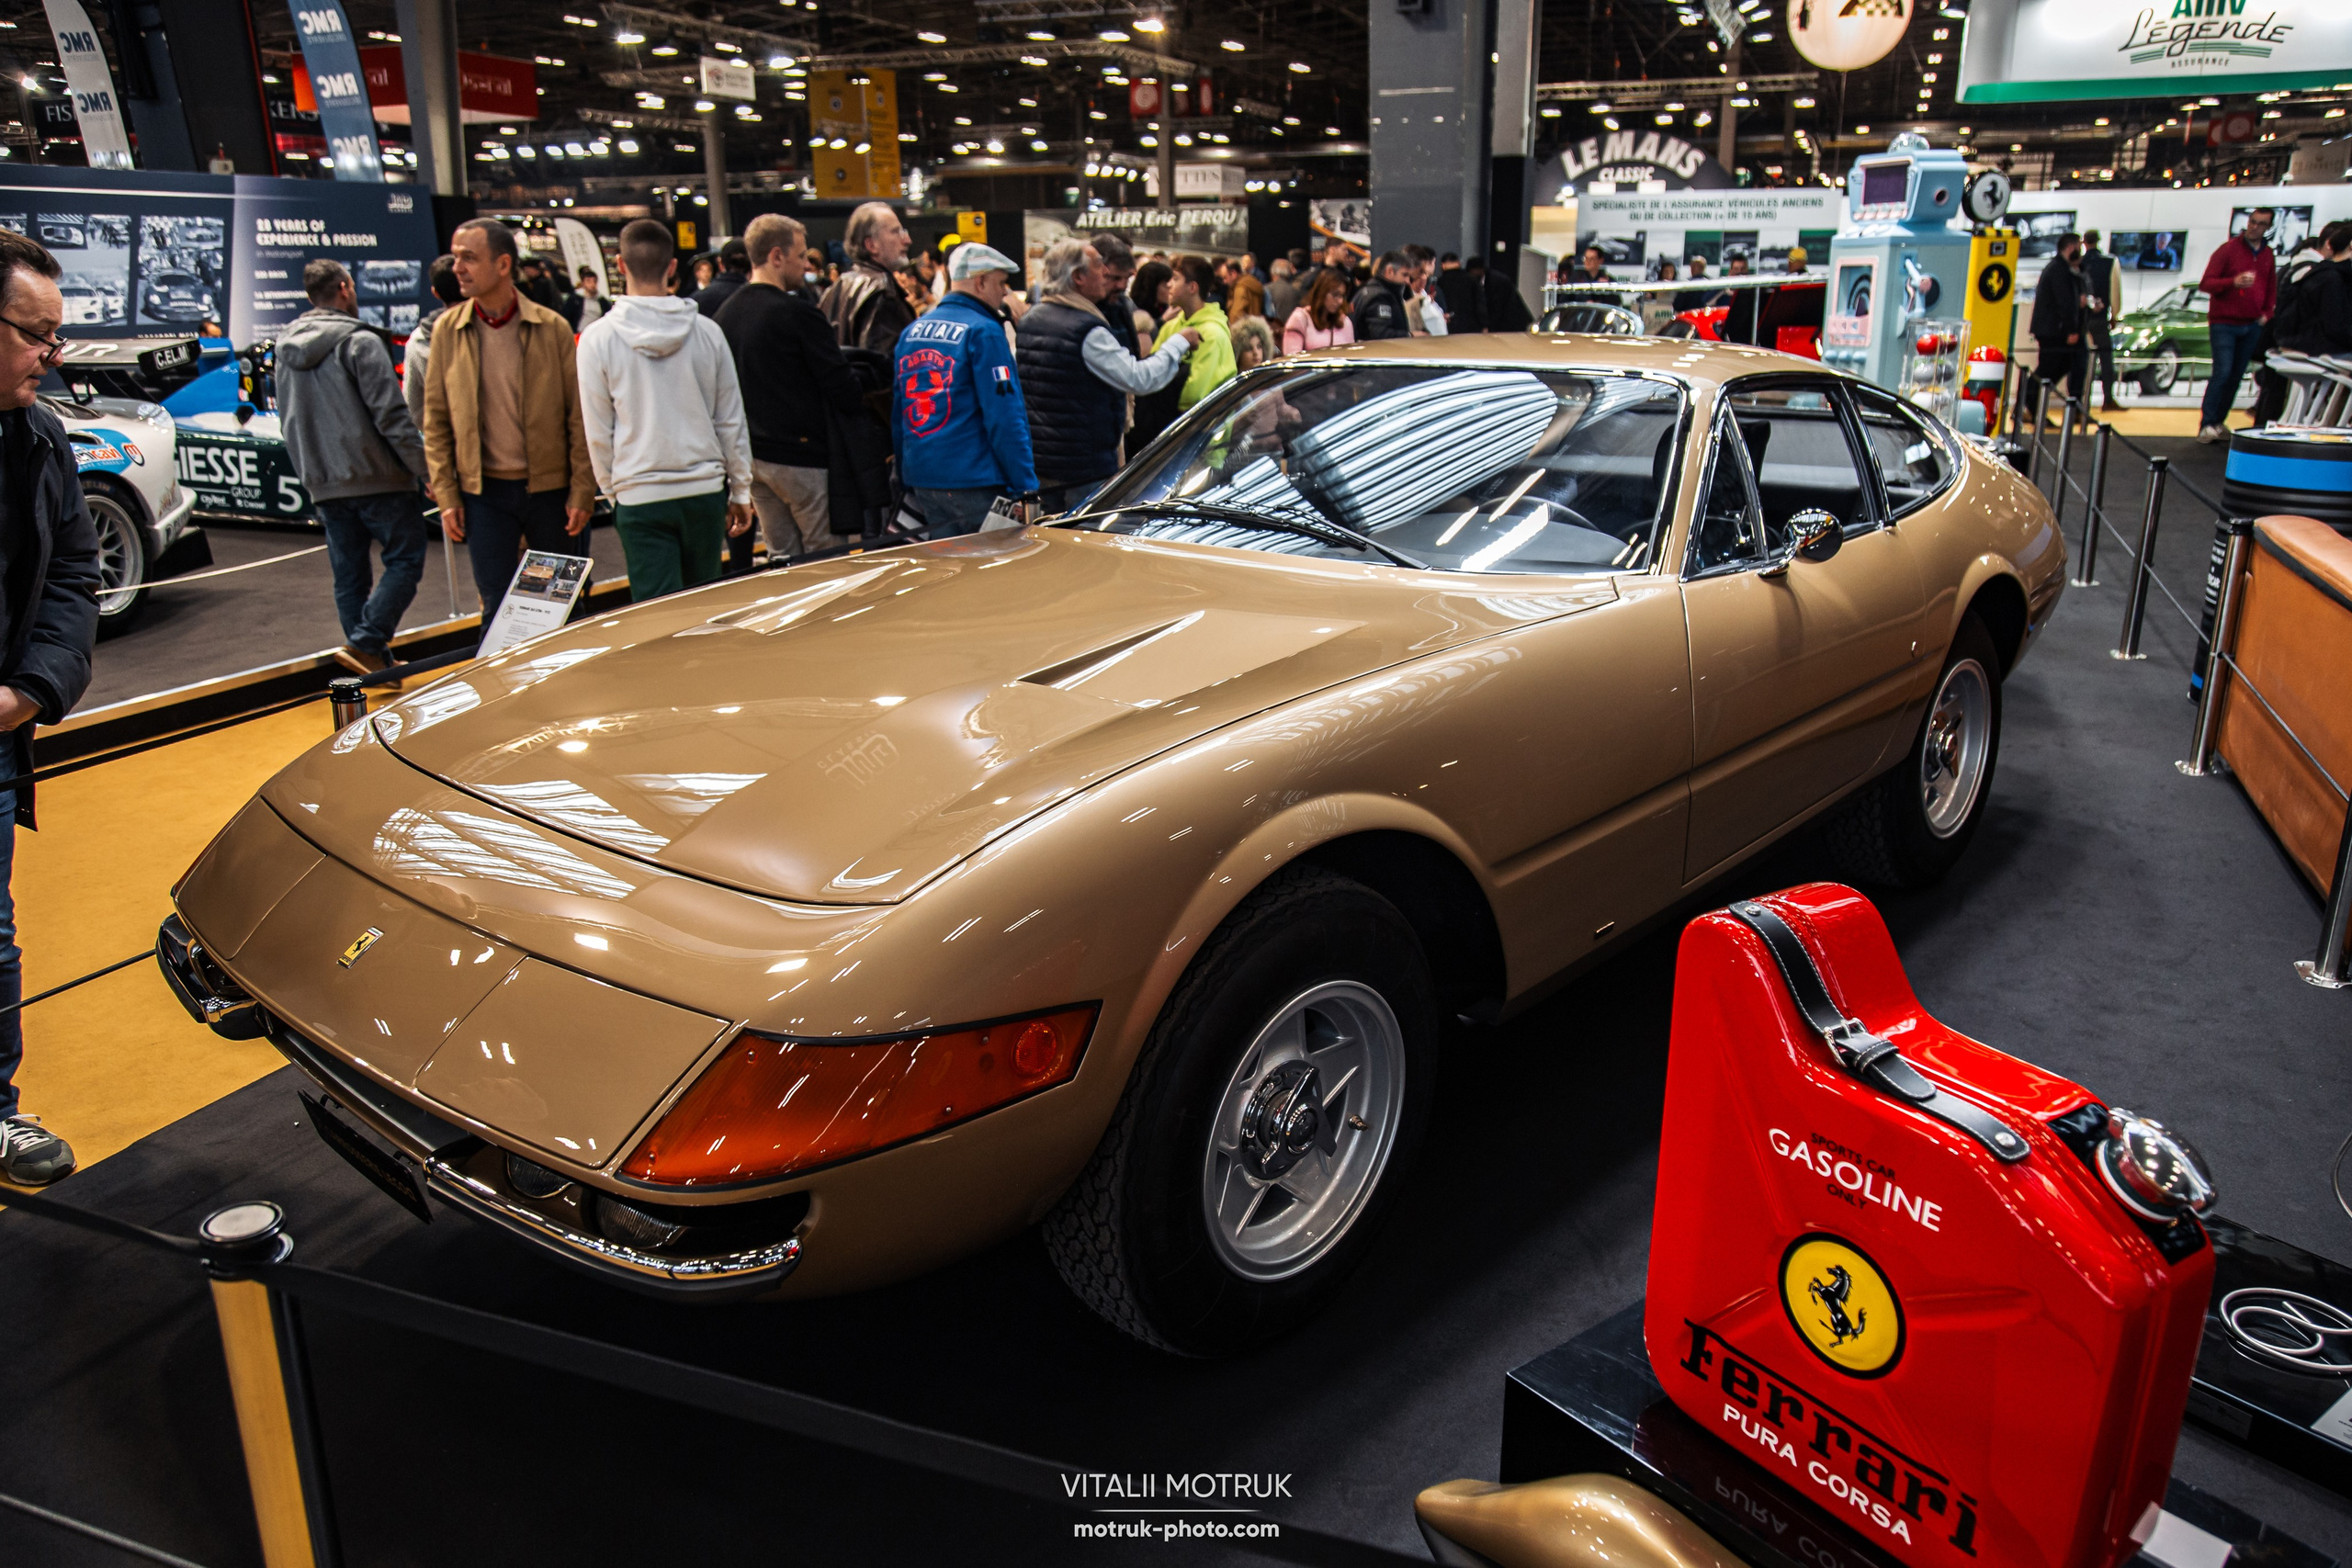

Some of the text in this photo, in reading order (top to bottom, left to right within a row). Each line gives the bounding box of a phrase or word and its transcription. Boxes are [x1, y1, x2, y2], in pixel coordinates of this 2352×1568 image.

[2119, 7, 2294, 57] Légende
[2171, 58, 2230, 68] ASSURANCE
[47, 105, 77, 122] FIS
[1562, 131, 1706, 181] LE MANS
[1599, 167, 1655, 183] CLASSIC
[1781, 197, 1824, 208] ANCIENS
[1076, 209, 1238, 229] ATELIER Eric PEROU
[1657, 210, 1713, 220] COLLECTION
[273, 219, 308, 232] YEARS
[310, 220, 325, 232] OF
[256, 232, 319, 246] EXPERIENCE
[333, 233, 378, 246] PASSION
[910, 322, 965, 341] FIAT
[907, 352, 944, 367] ABARTH
[231, 486, 262, 499] GROUP
[278, 475, 303, 513] 5
[1811, 1133, 1895, 1181] SPORTS CAR
[1769, 1128, 1943, 1232] GASOLINE
[1826, 1183, 1868, 1211] ONLY
[1679, 1317, 1979, 1559] Ferrari
[1723, 1404, 1912, 1546] PURA CORSA
